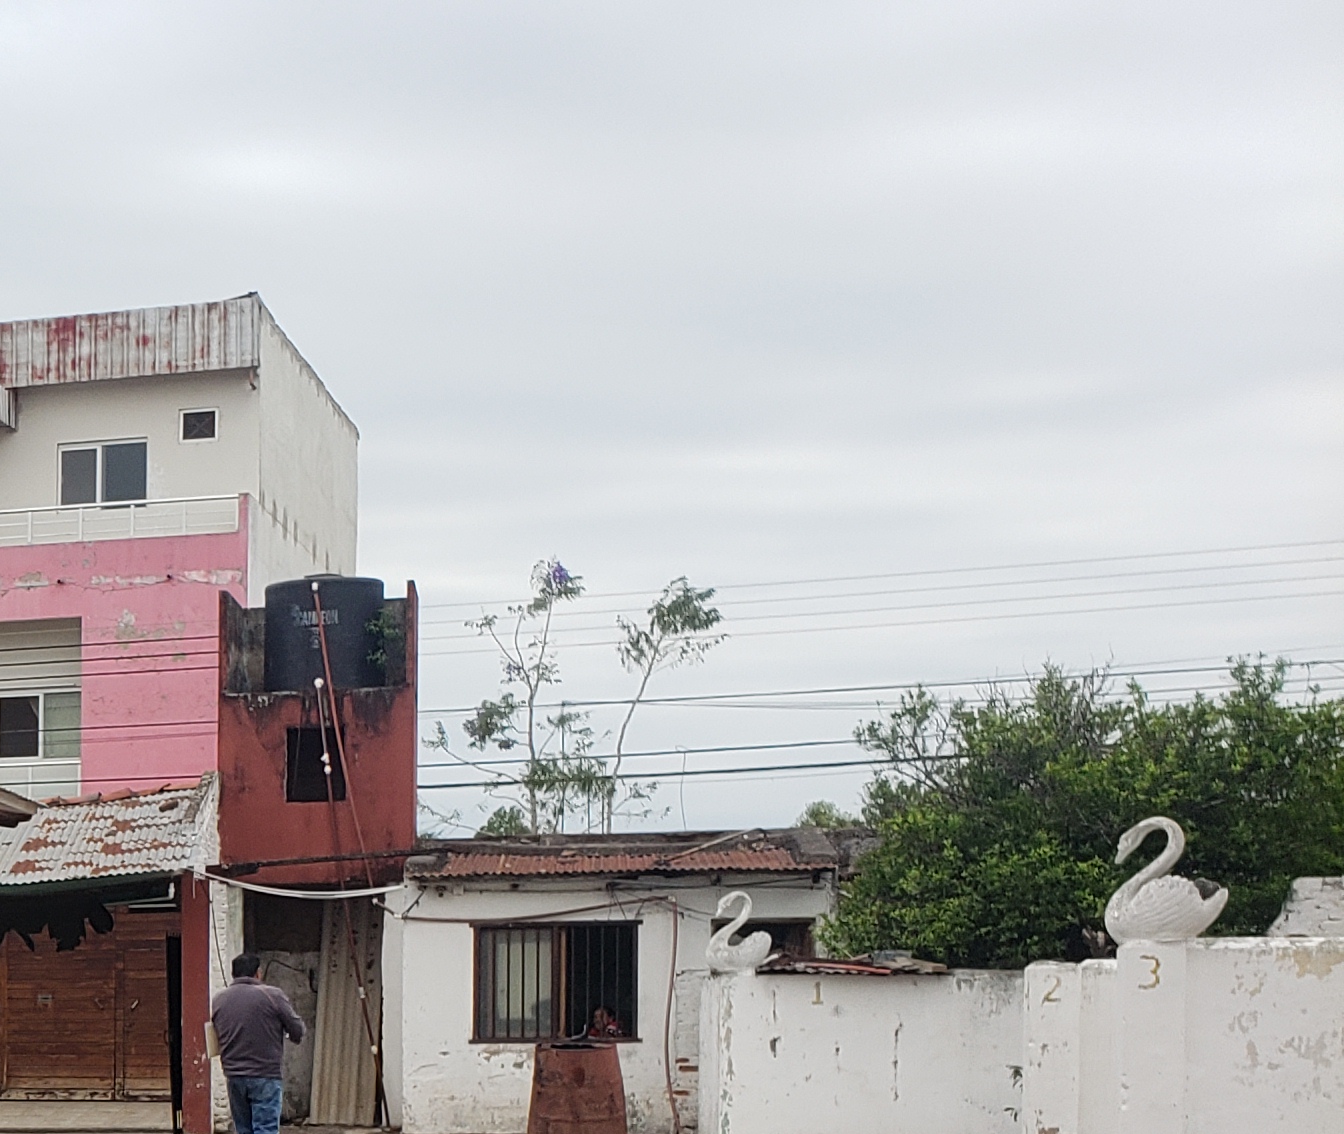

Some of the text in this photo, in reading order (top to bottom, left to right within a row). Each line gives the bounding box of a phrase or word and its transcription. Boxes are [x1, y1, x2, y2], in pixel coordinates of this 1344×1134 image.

[1138, 955, 1160, 990] 3
[812, 981, 824, 1006] 1
[1041, 975, 1061, 1005] 2
